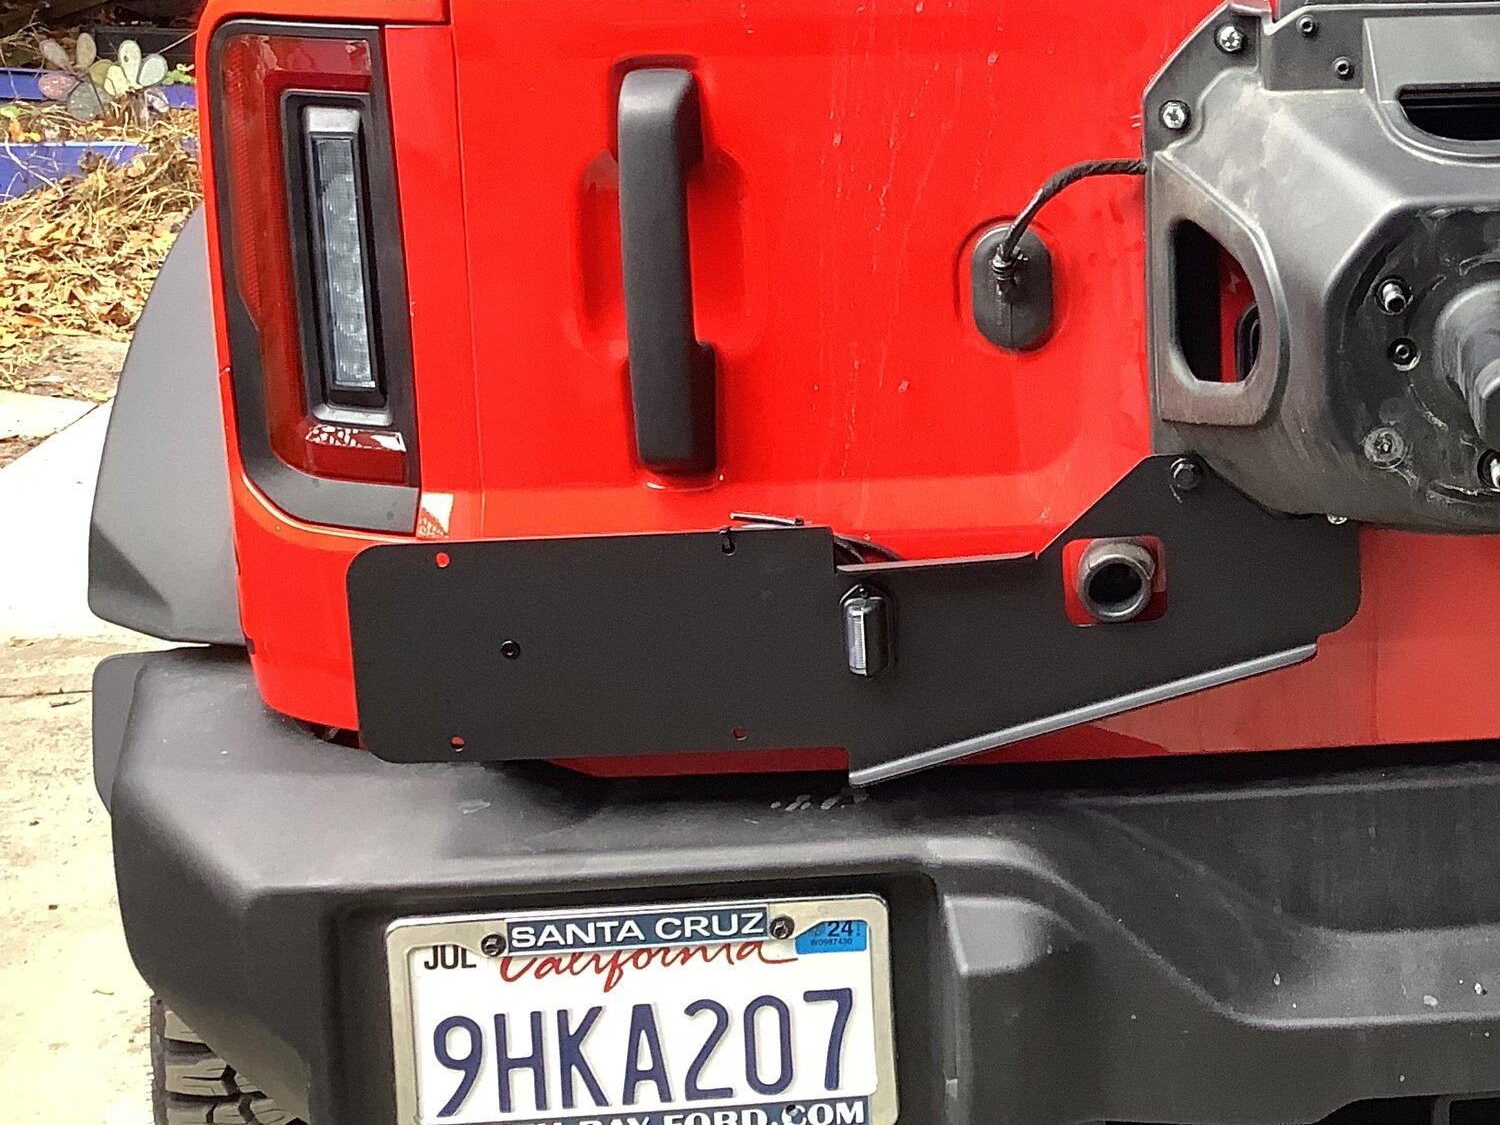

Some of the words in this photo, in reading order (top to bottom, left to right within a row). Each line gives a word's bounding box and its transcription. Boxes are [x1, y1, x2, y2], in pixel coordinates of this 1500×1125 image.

[511, 920, 639, 948] SANTA
[667, 912, 765, 938] CRUZ
[424, 945, 477, 970] JUL
[433, 987, 854, 1118] 9HKA207
